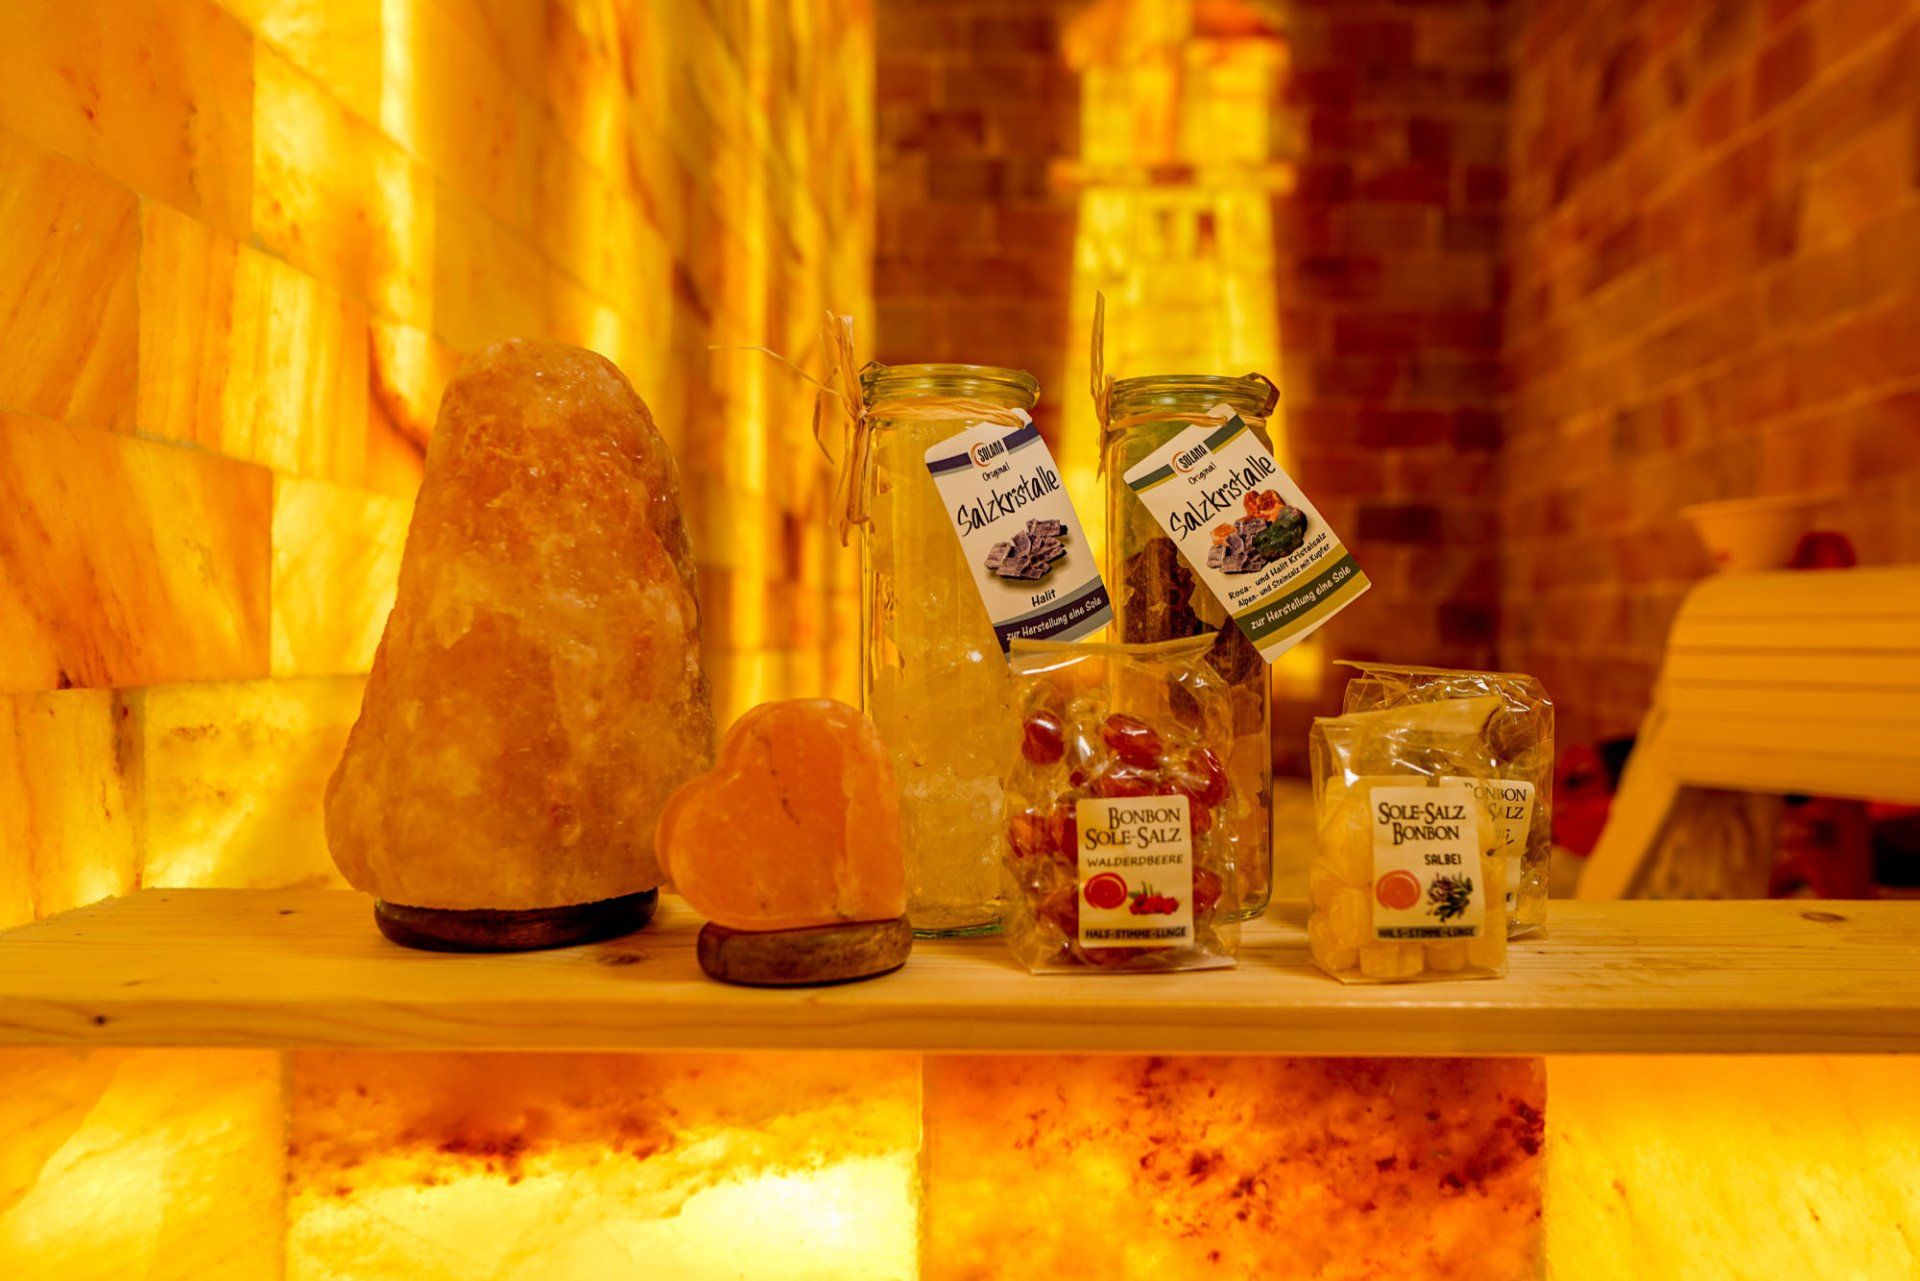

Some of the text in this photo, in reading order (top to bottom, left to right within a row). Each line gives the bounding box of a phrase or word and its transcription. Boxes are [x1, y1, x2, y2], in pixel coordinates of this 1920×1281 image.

[982, 461, 1010, 481] Original
[1187, 461, 1217, 485] Original
[957, 465, 1060, 537] Salzkristalle
[1169, 455, 1276, 541] Salzkristalle
[1238, 542, 1331, 608] Alpen- und Steinsalz mit Kupfer
[1255, 574, 1270, 586] und
[1270, 560, 1289, 577] Halit
[1031, 588, 1056, 607] Halit
[1250, 565, 1352, 631] zur Herstellung eine Sole
[1006, 596, 1102, 641] zur Herstellung eine Sole
[1108, 806, 1182, 831] BONBON
[1378, 801, 1467, 825] SOLE-SALZ
[1085, 826, 1182, 851] SOLE-SALZ
[1392, 822, 1460, 846] BONBON
[1086, 853, 1184, 868] WALDERDBEERE
[1424, 853, 1462, 866] SALBEI
